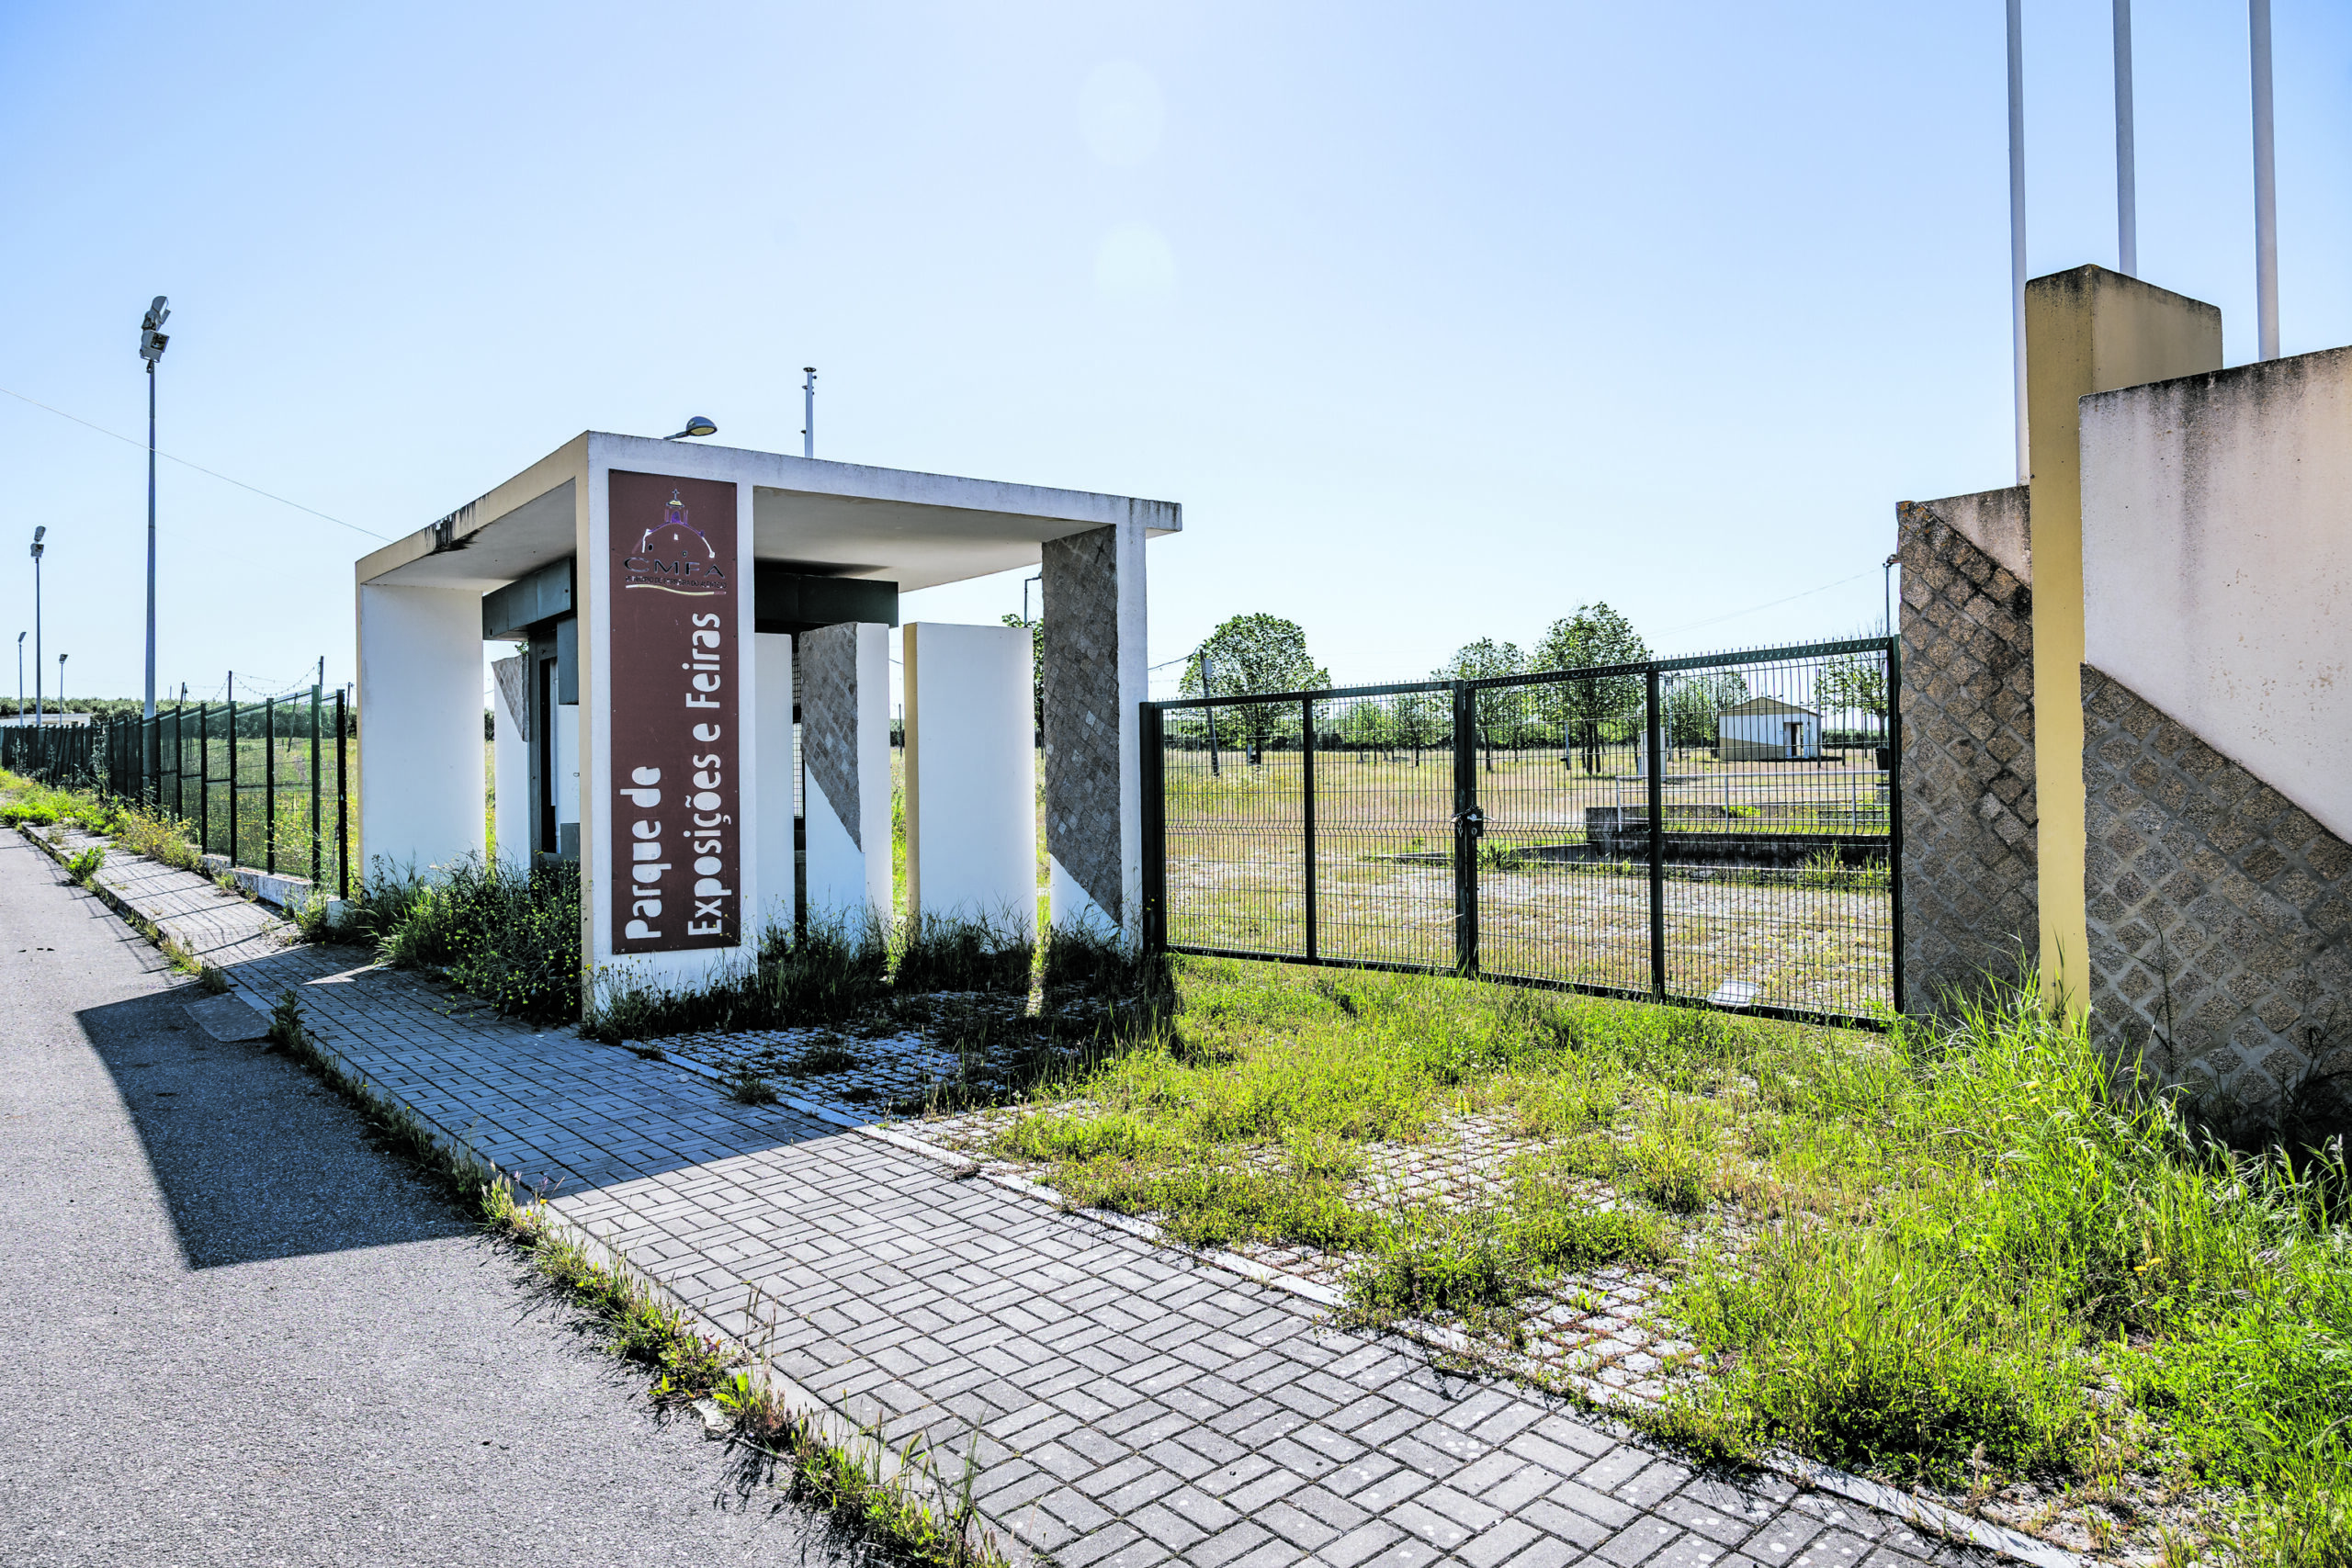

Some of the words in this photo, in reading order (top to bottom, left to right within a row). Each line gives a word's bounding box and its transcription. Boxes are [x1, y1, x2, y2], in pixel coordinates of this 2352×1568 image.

[624, 558, 725, 579] CMFA
[683, 614, 721, 708] Feiras
[693, 724, 721, 742] e
[620, 766, 662, 808] de
[683, 754, 732, 936] Exposições
[626, 819, 673, 940] Parque
